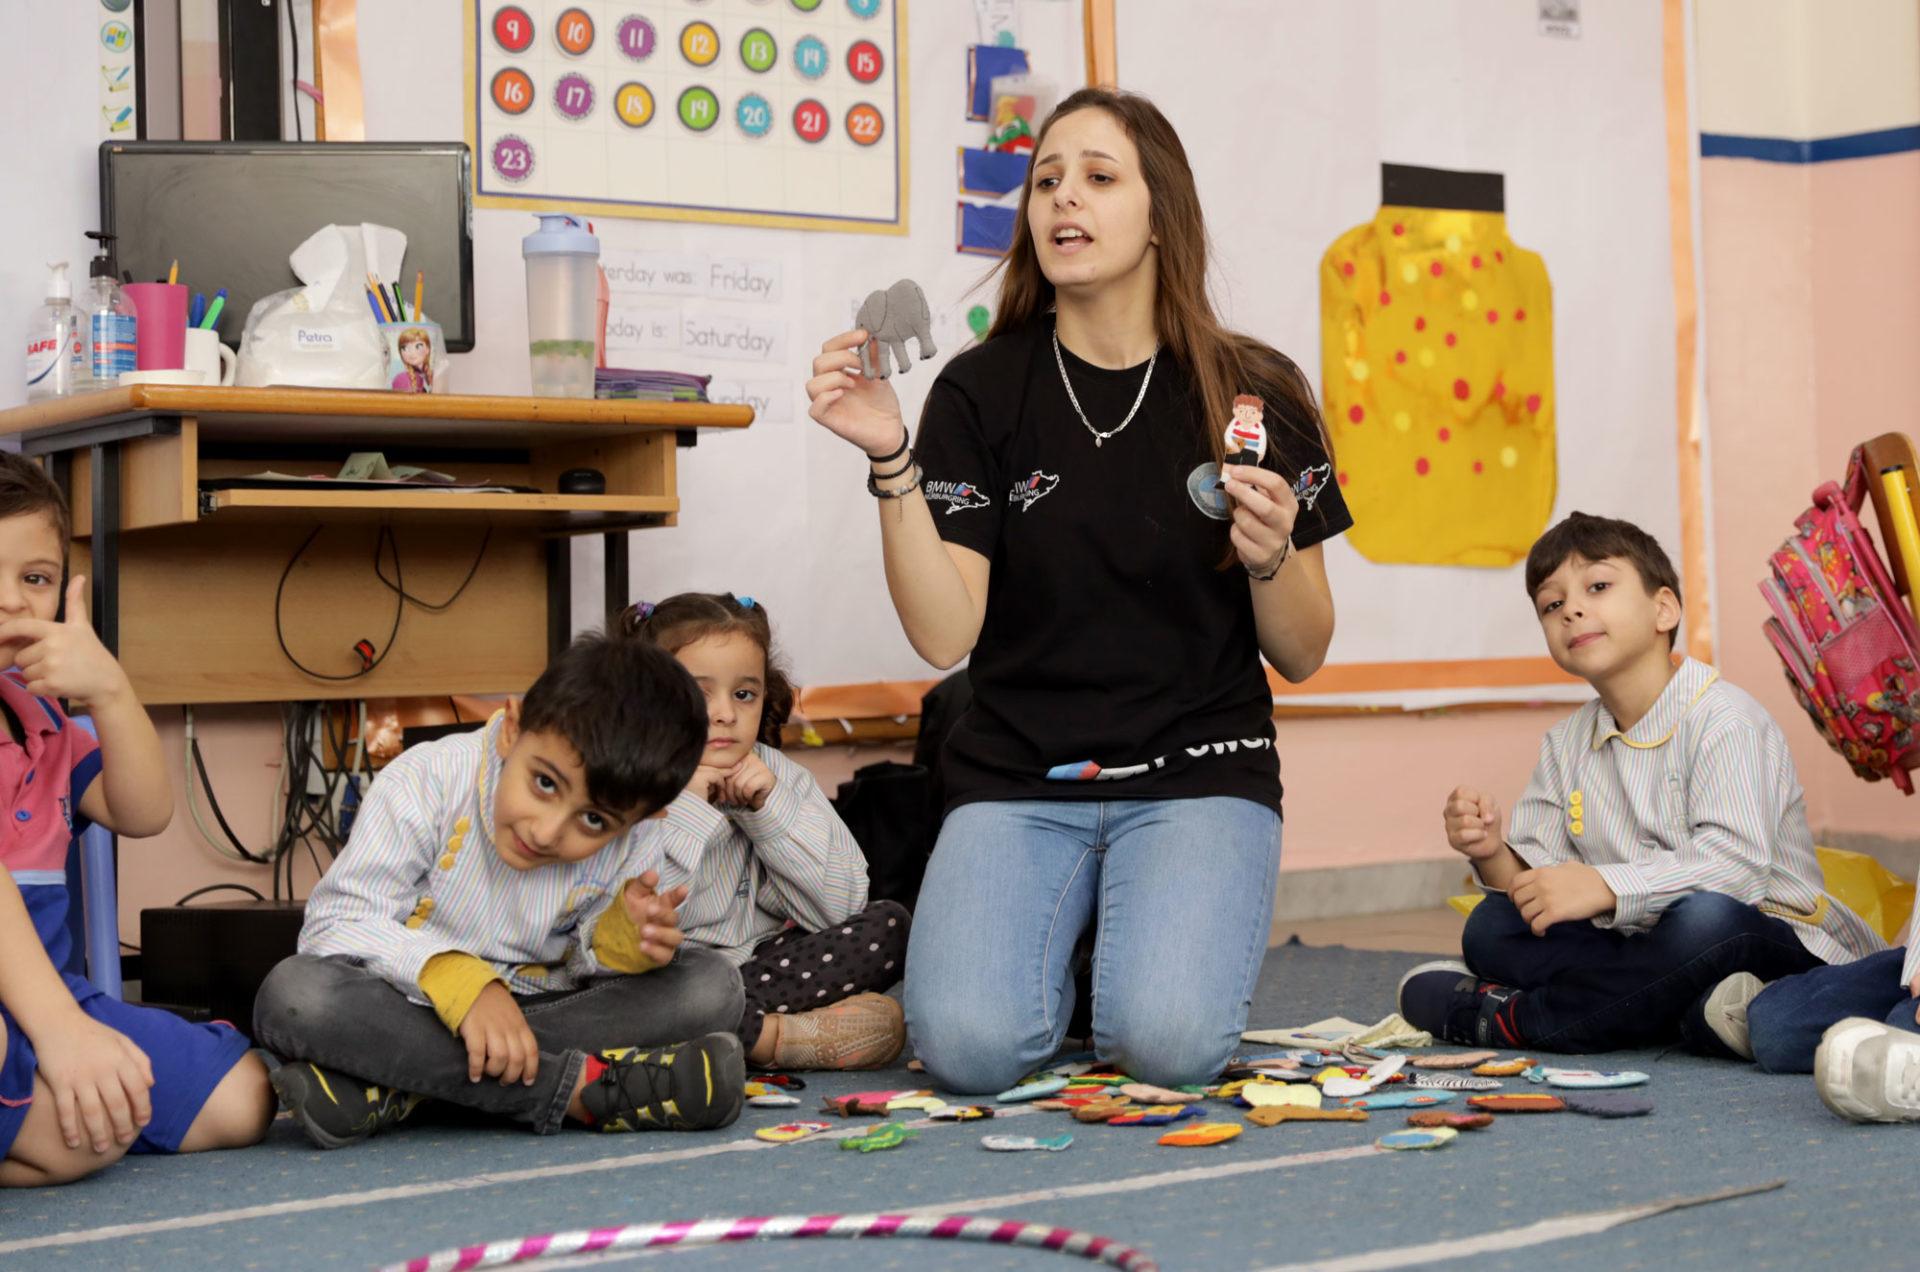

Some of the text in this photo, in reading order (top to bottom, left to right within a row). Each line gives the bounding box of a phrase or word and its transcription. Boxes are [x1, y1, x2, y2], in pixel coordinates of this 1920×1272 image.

[506, 19, 875, 73] 9 10 11 12 13 14 15
[504, 80, 876, 136] 16 17 18 19 20 21 22
[500, 148, 526, 171] 23
[710, 264, 773, 297] Friday
[686, 320, 774, 357] Saturday
[926, 480, 957, 494] BMW
